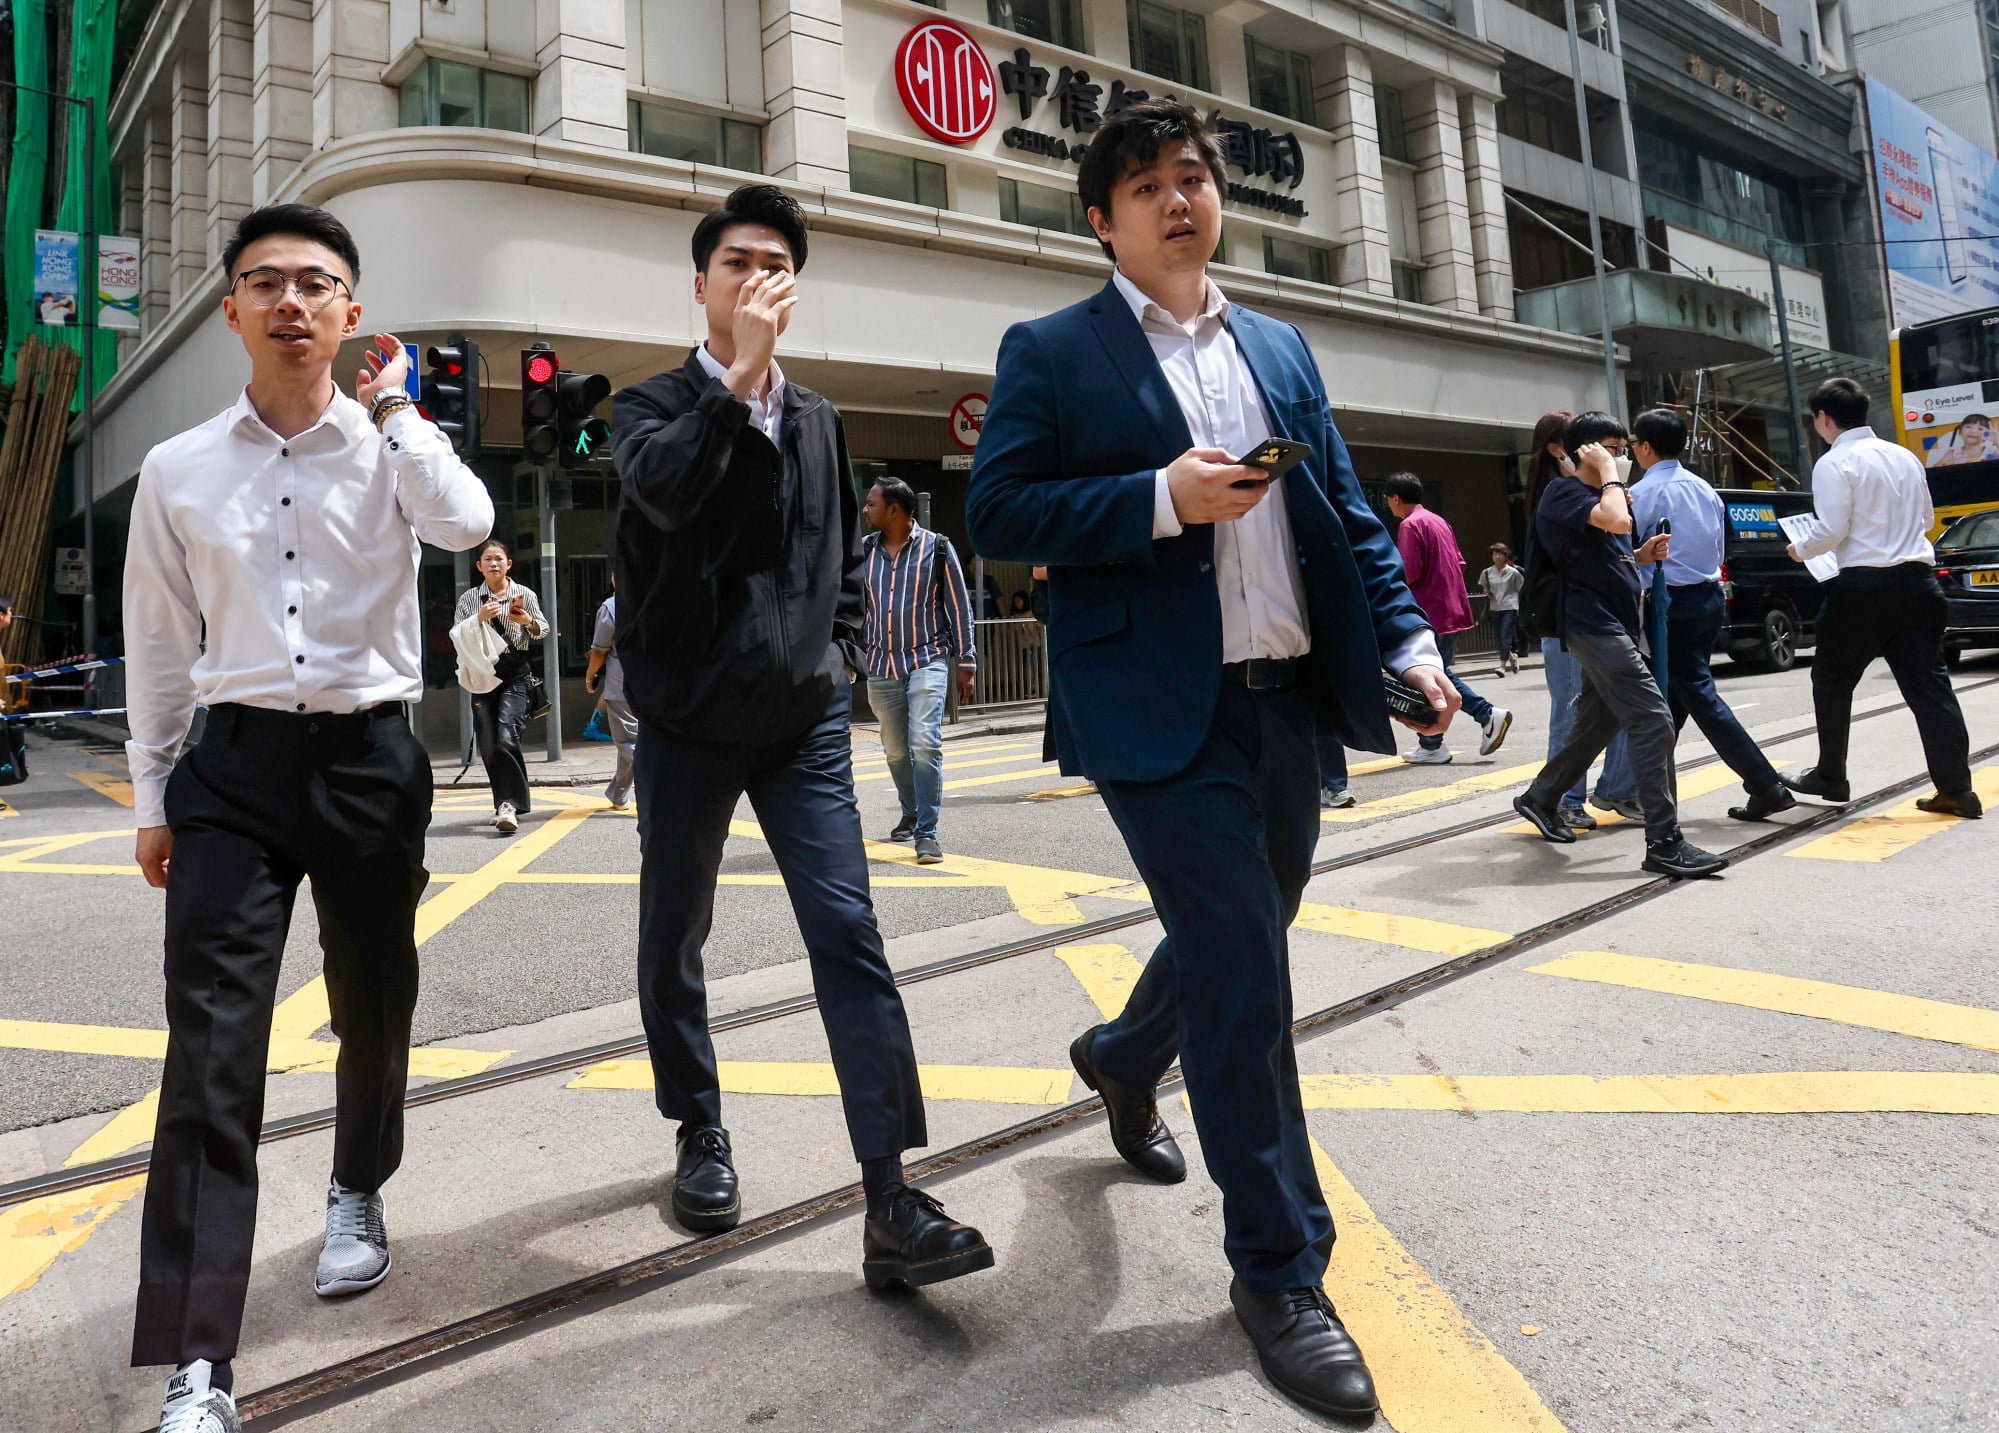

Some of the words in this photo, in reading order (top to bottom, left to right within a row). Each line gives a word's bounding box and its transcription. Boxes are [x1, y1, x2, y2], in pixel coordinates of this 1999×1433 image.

[1003, 127, 1070, 160] CHINA
[47, 250, 68, 258] LINK
[42, 257, 73, 266] HONG
[42, 264, 72, 274] KONG
[101, 267, 137, 277] HONG
[42, 272, 70, 280] OPEN
[101, 275, 137, 285] KONG
[1935, 397, 1951, 406] Eye
[1952, 394, 1974, 403] Level
[168, 1372, 188, 1392] NIKE
